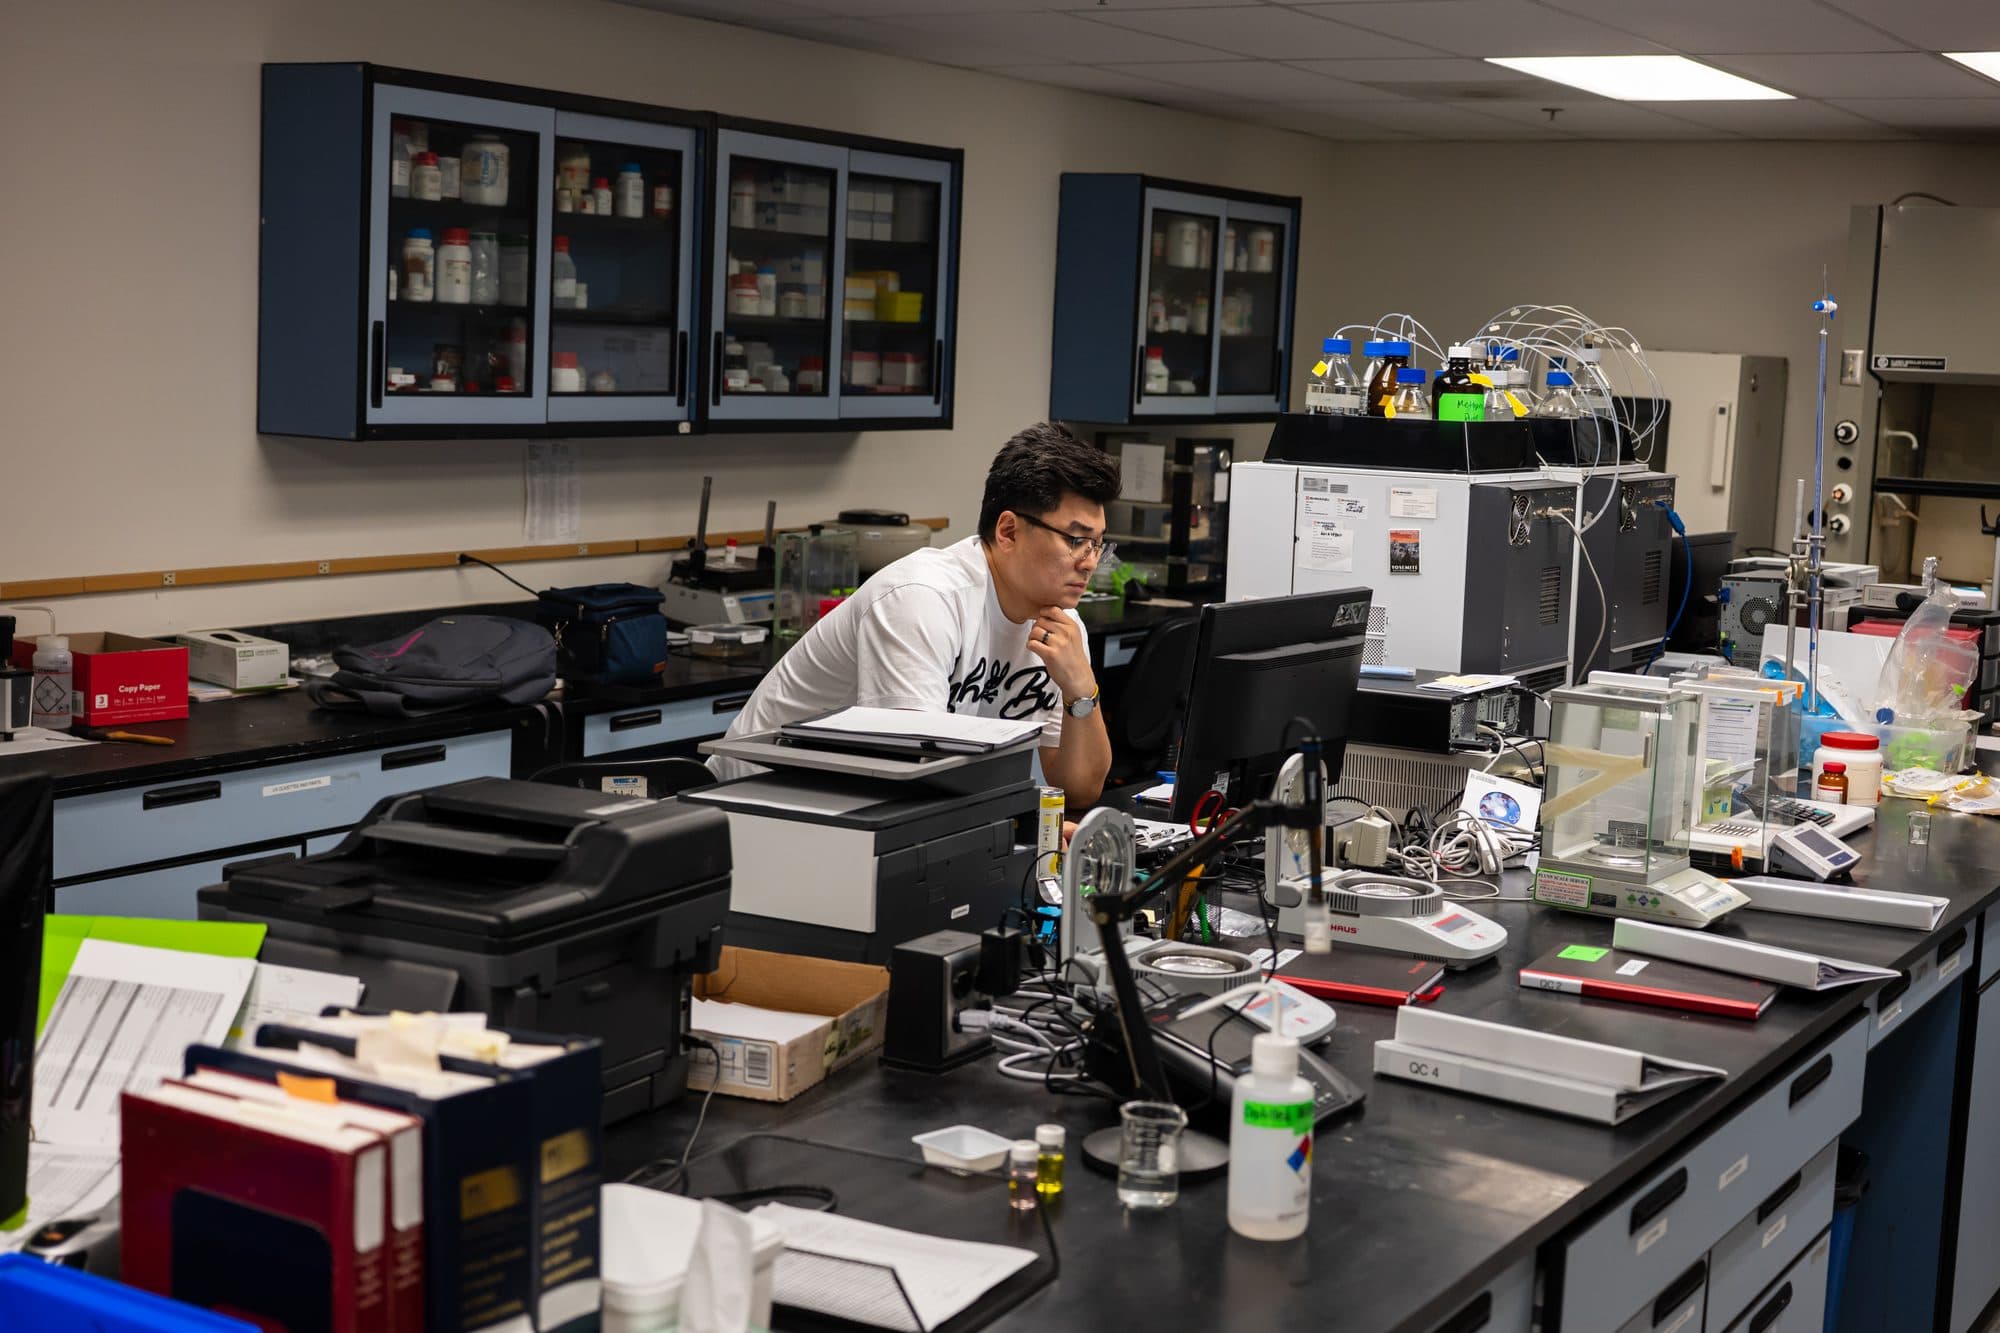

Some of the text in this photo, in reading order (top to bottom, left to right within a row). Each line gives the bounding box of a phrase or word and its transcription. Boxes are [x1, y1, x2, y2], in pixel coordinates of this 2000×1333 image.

[118, 684, 161, 693] Copy Paper
[1330, 924, 1358, 934] HAUS
[1540, 979, 1562, 990] QC 2
[1409, 1062, 1439, 1078] QC 4
